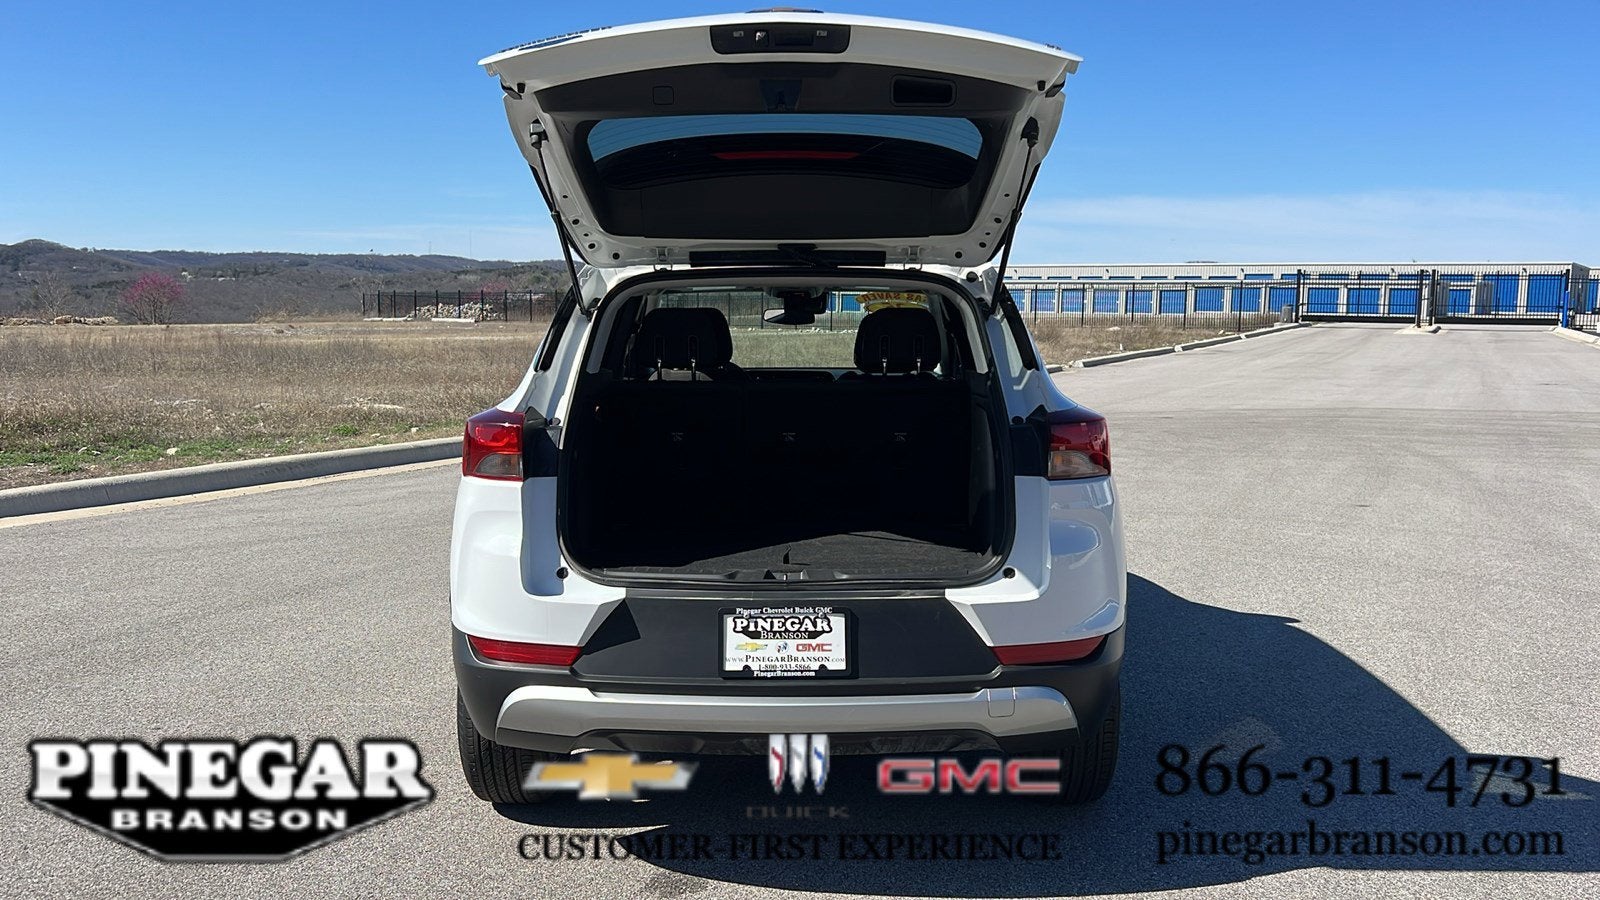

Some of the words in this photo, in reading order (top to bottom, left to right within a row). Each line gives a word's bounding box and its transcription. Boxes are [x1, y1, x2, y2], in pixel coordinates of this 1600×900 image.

[736, 608, 761, 616] Pinegar
[734, 618, 831, 632] PINEGAR
[796, 643, 832, 652] GMC
